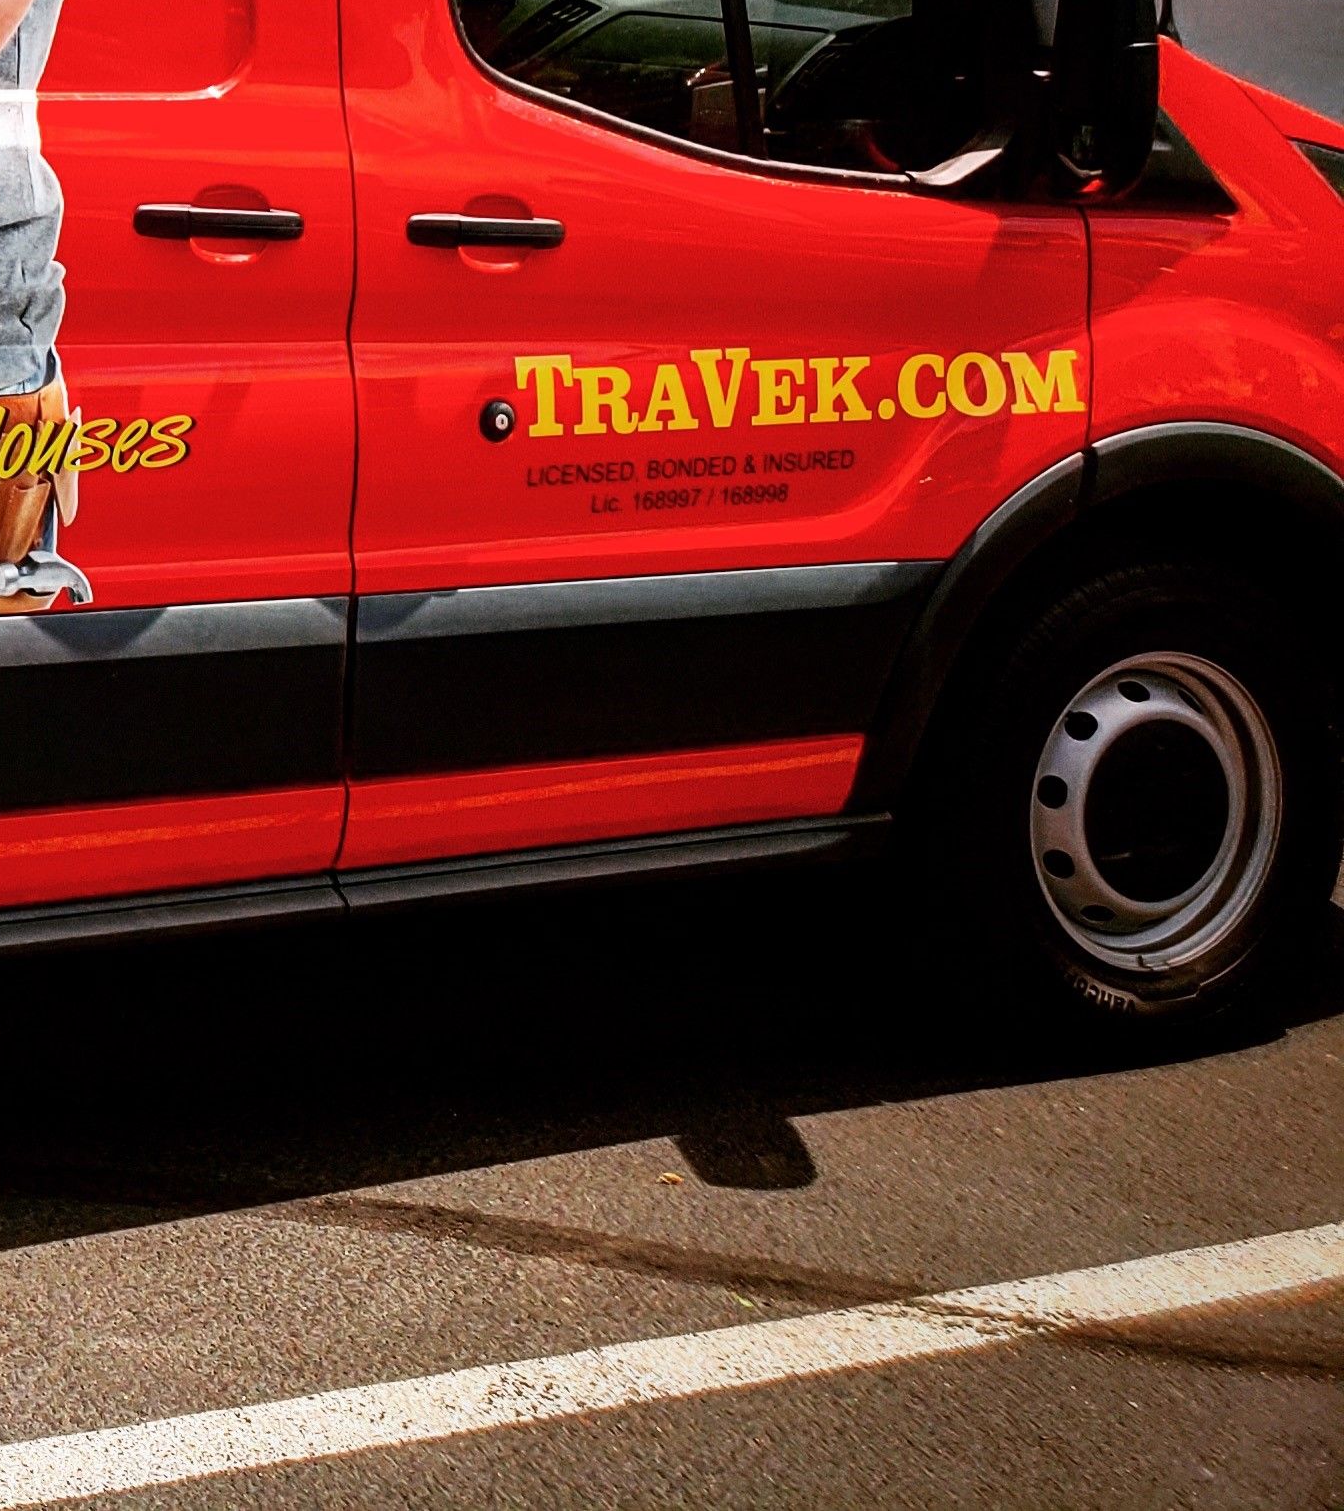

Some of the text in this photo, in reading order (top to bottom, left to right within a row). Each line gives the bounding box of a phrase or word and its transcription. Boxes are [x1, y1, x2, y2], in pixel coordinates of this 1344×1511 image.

[647, 455, 737, 479] BONDED
[744, 454, 756, 474] &
[763, 449, 855, 473] INSURED
[634, 488, 701, 510] 168997
[722, 483, 789, 505] 168998
